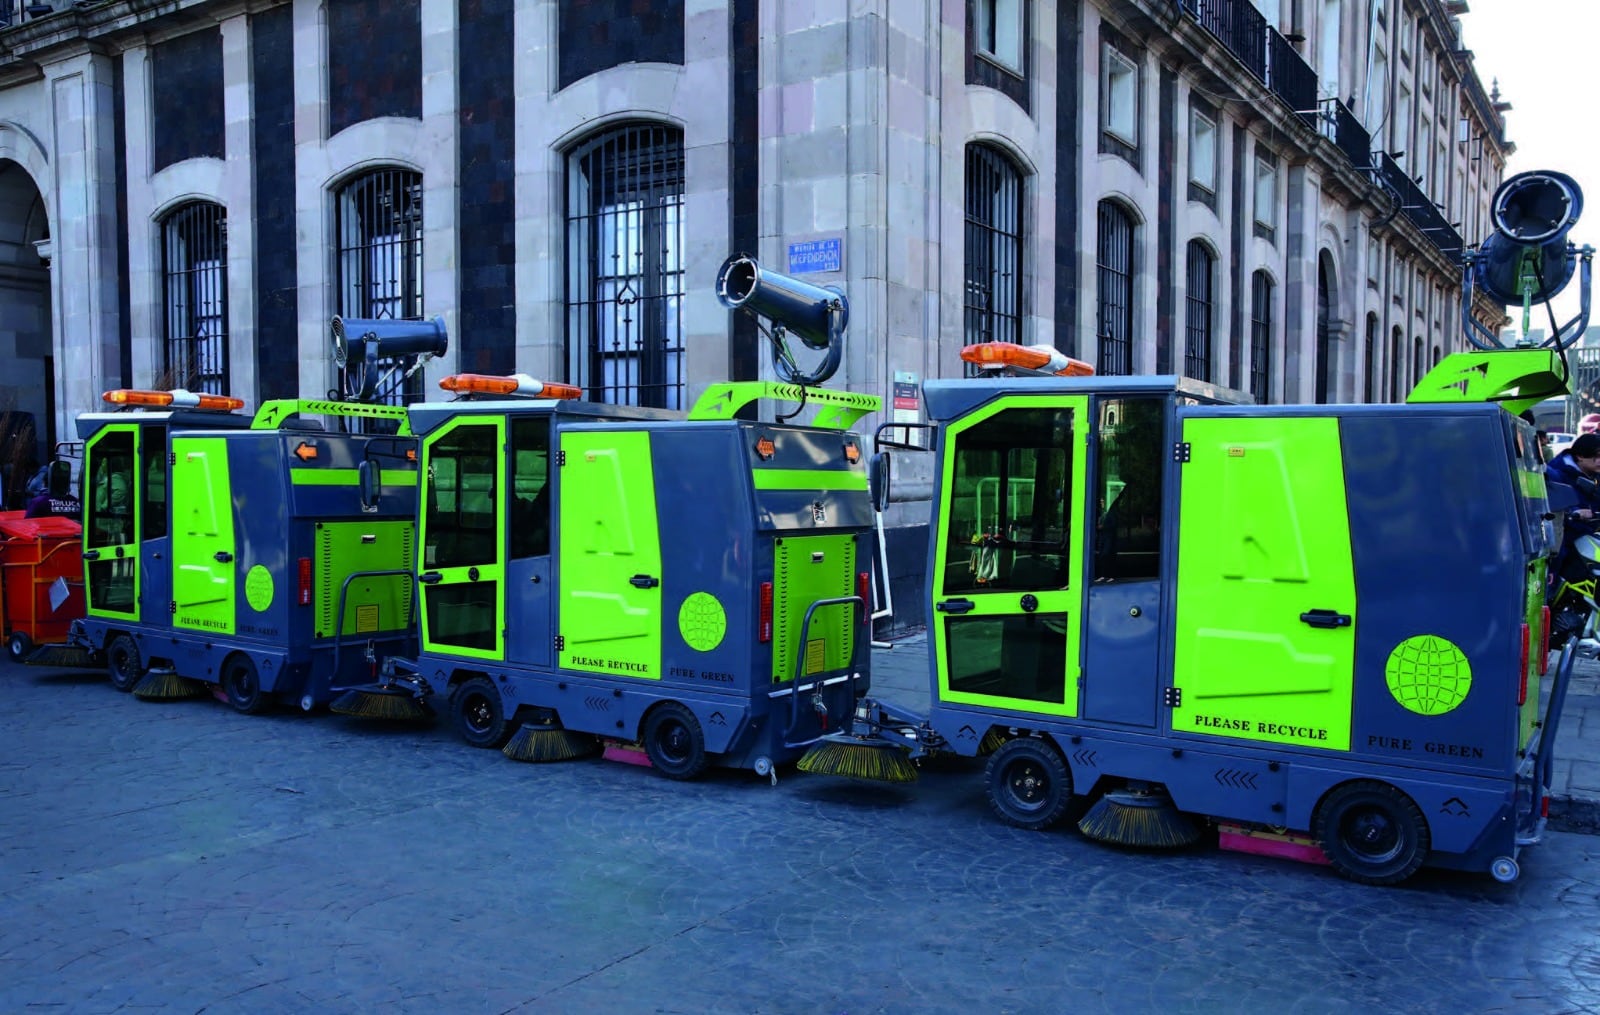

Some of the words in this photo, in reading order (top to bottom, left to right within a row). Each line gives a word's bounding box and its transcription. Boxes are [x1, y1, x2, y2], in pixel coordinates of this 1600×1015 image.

[827, 240, 834, 248] LA
[572, 656, 605, 667] PLEASE
[608, 660, 648, 672] RECYCLE
[670, 667, 695, 678] PURE
[701, 671, 734, 682] GREEN
[1195, 715, 1250, 731] PLEASE
[1258, 722, 1328, 740] RECYCLE
[1368, 735, 1412, 750] PURE
[1424, 742, 1483, 758] GREEN
